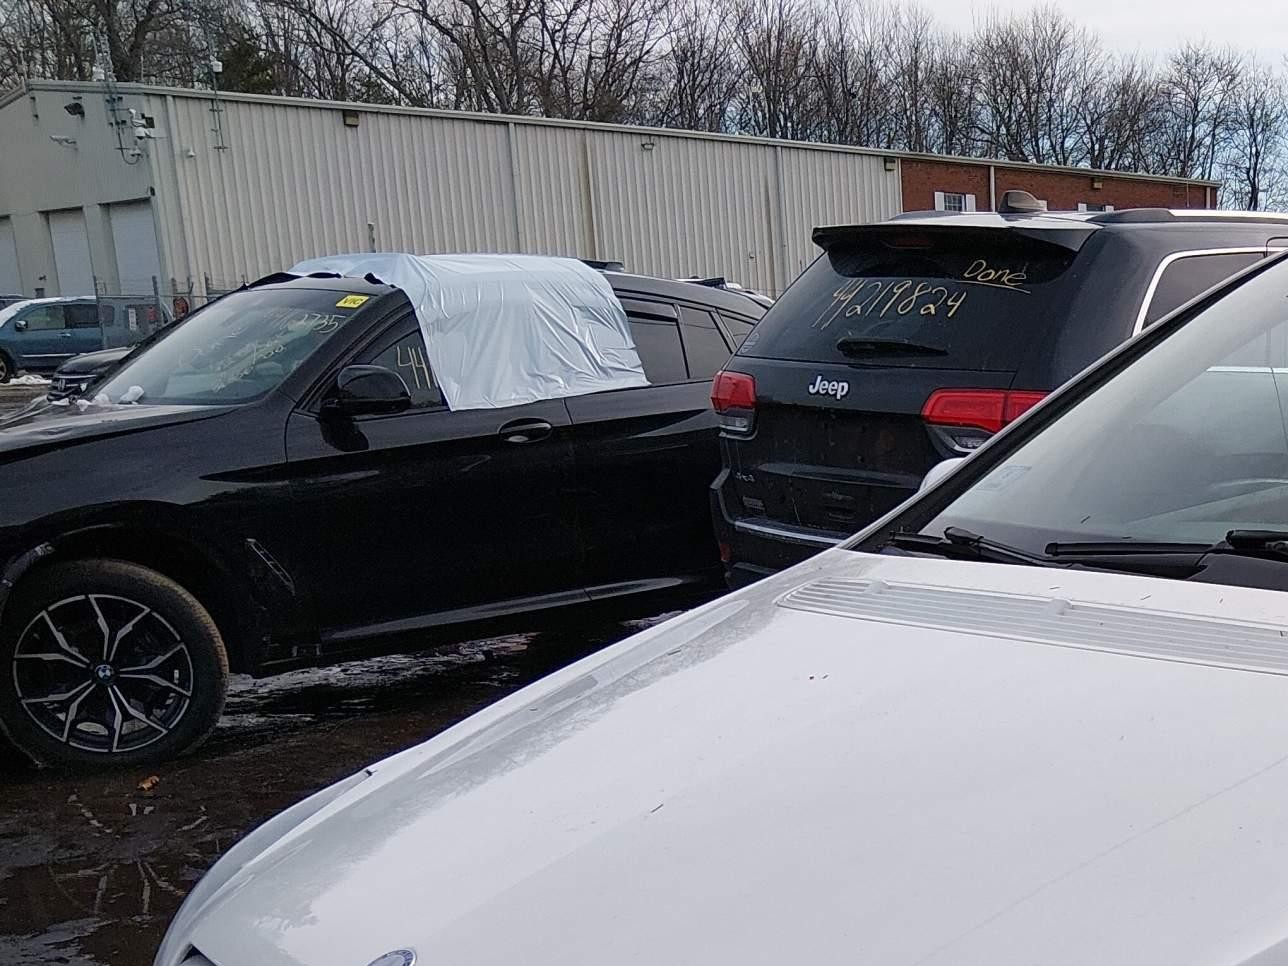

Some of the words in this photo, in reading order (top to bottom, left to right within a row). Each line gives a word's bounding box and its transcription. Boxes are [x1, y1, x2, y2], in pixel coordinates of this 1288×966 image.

[963, 259, 1028, 287] Done
[811, 276, 967, 331] 44219824
[808, 375, 850, 400] Jeep
